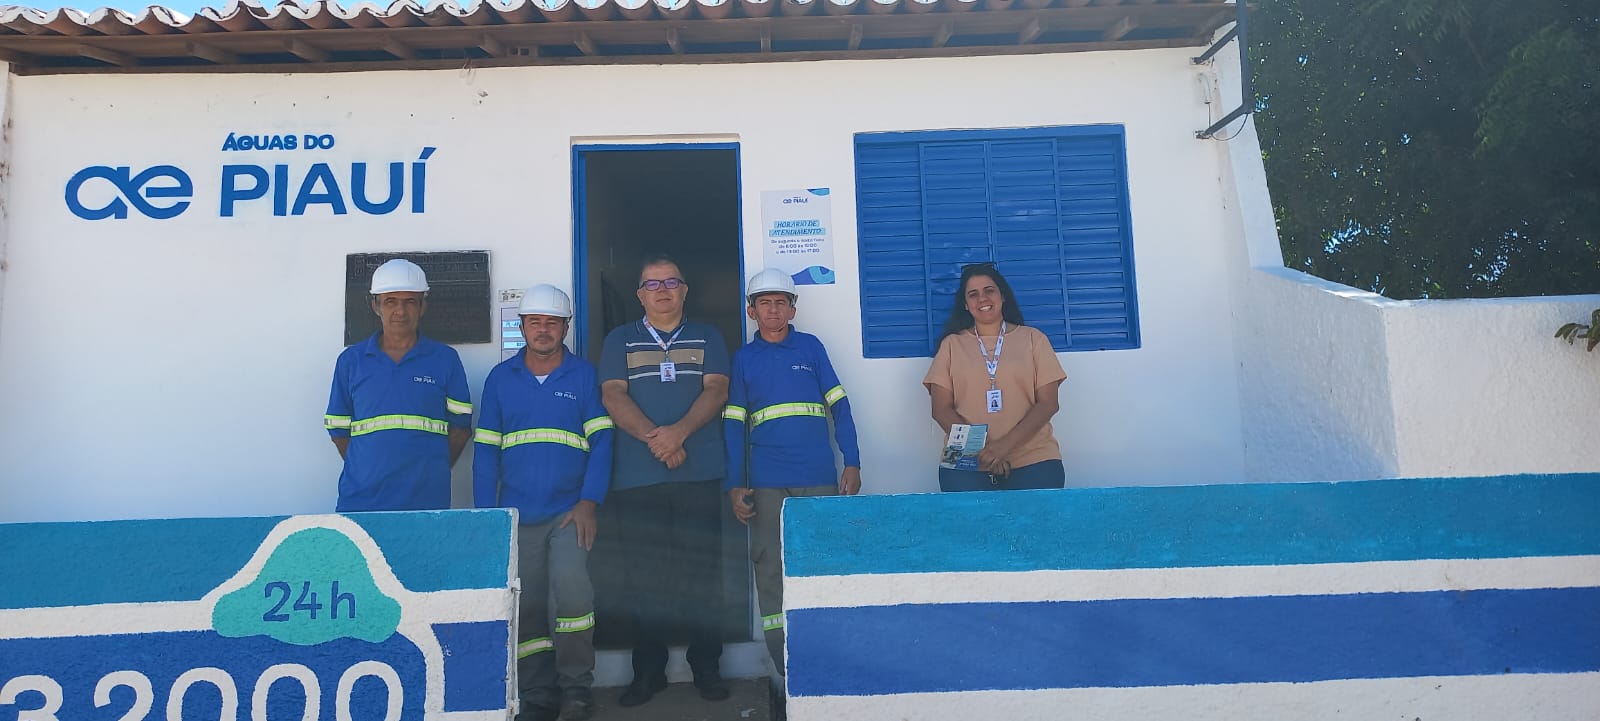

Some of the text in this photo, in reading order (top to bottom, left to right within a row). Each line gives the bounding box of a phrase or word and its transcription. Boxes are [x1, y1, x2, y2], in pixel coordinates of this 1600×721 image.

[222, 132, 335, 151] ÁGUAS DO
[219, 147, 437, 217] PIAUÍ
[807, 219, 818, 227] DE
[772, 228, 822, 236] ATENDIMENTO
